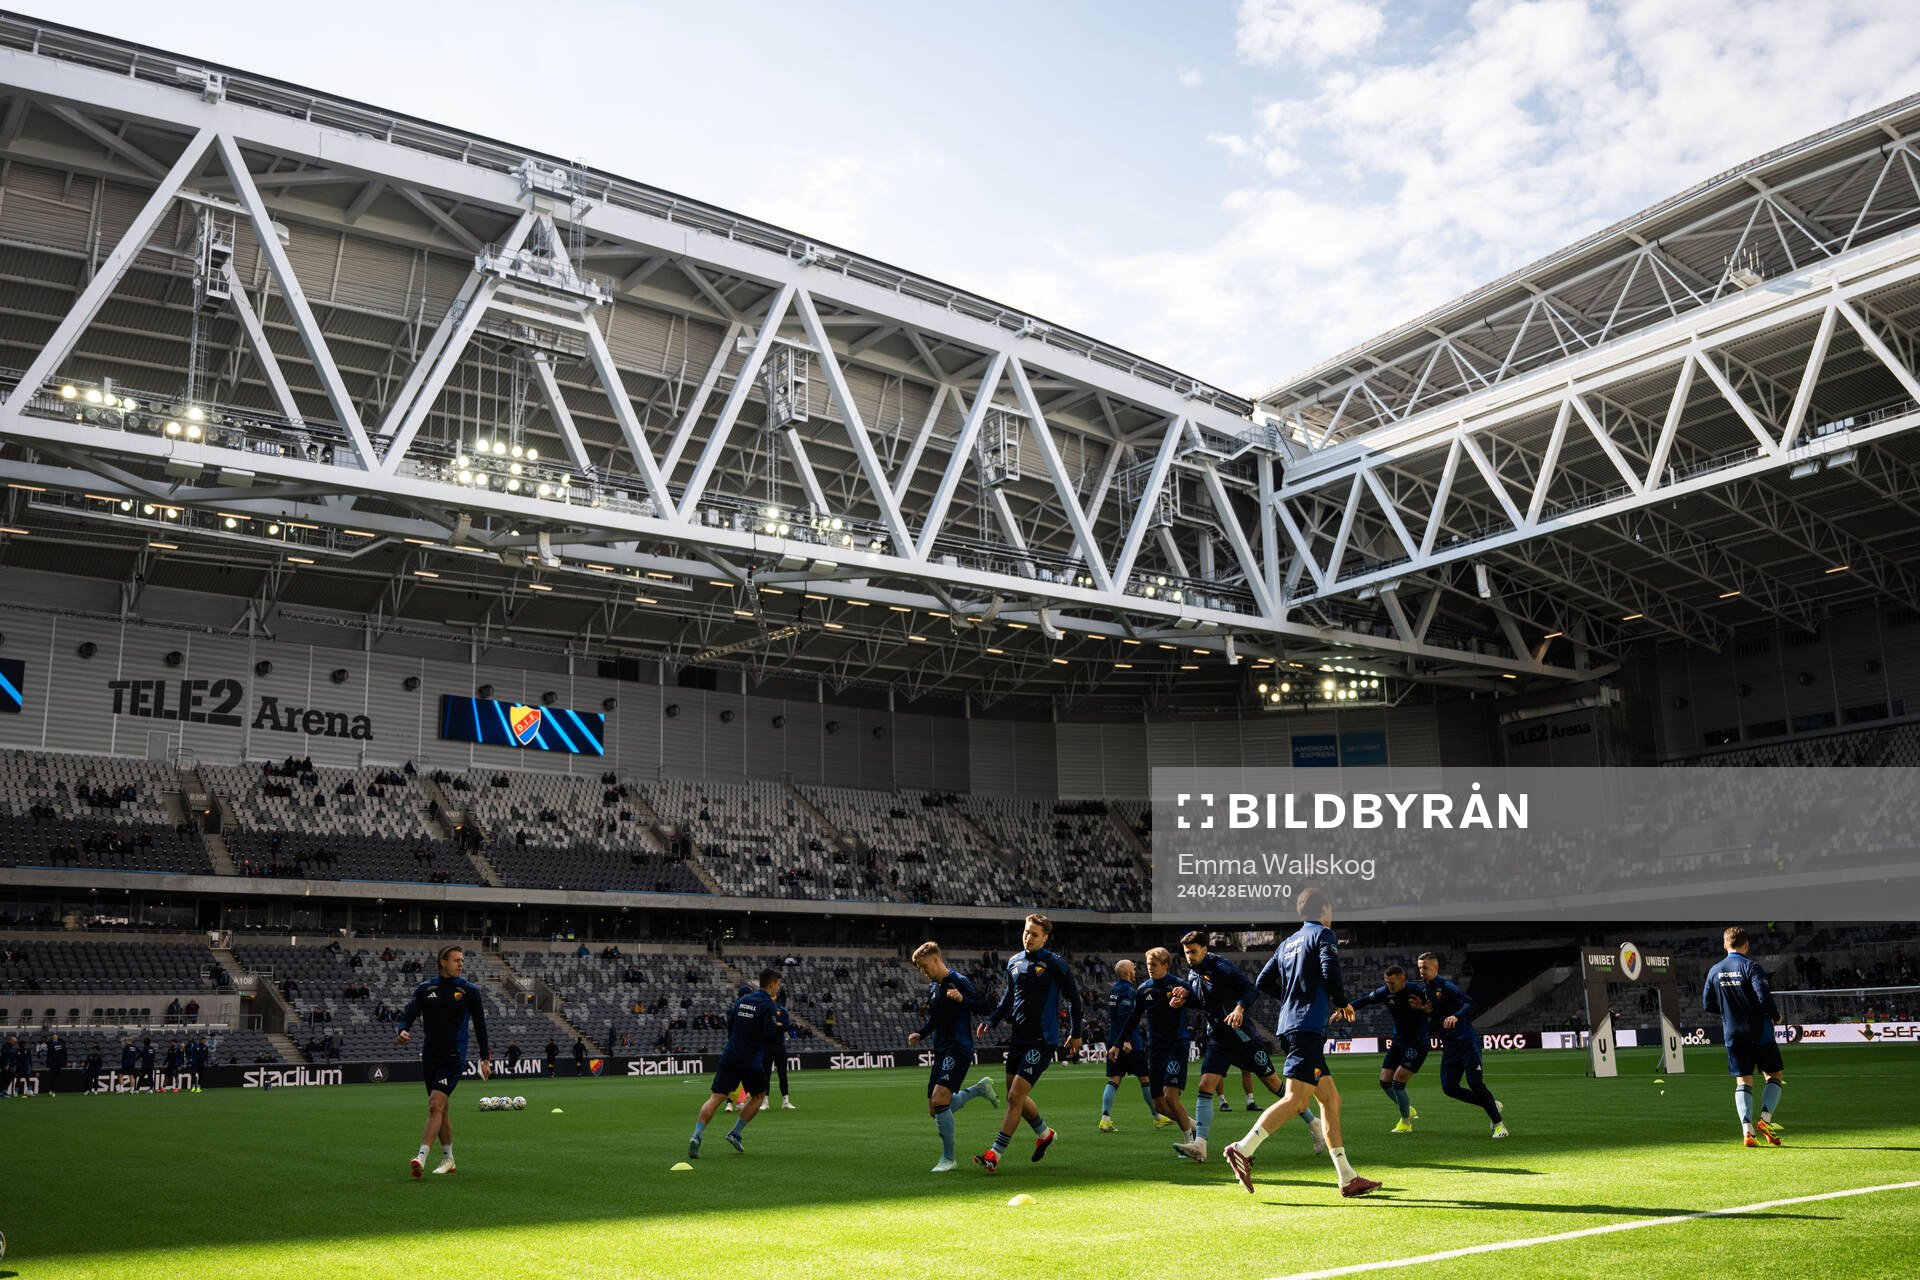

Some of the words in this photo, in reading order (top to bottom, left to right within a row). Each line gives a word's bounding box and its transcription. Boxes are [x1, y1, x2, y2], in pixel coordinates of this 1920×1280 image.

[108, 679, 243, 727] TELE2
[252, 696, 373, 740] Arena
[1510, 723, 1548, 745] TELE2
[1551, 722, 1592, 739] Arena
[1294, 744, 1335, 753] AMERICAN
[1588, 954, 1615, 966] UNIBET
[1645, 955, 1670, 967] UNIBET
[1483, 1033, 1526, 1049] BYGG
[627, 1055, 703, 1076] stadium
[830, 1052, 895, 1069] stadium
[243, 1066, 342, 1088] stadium
